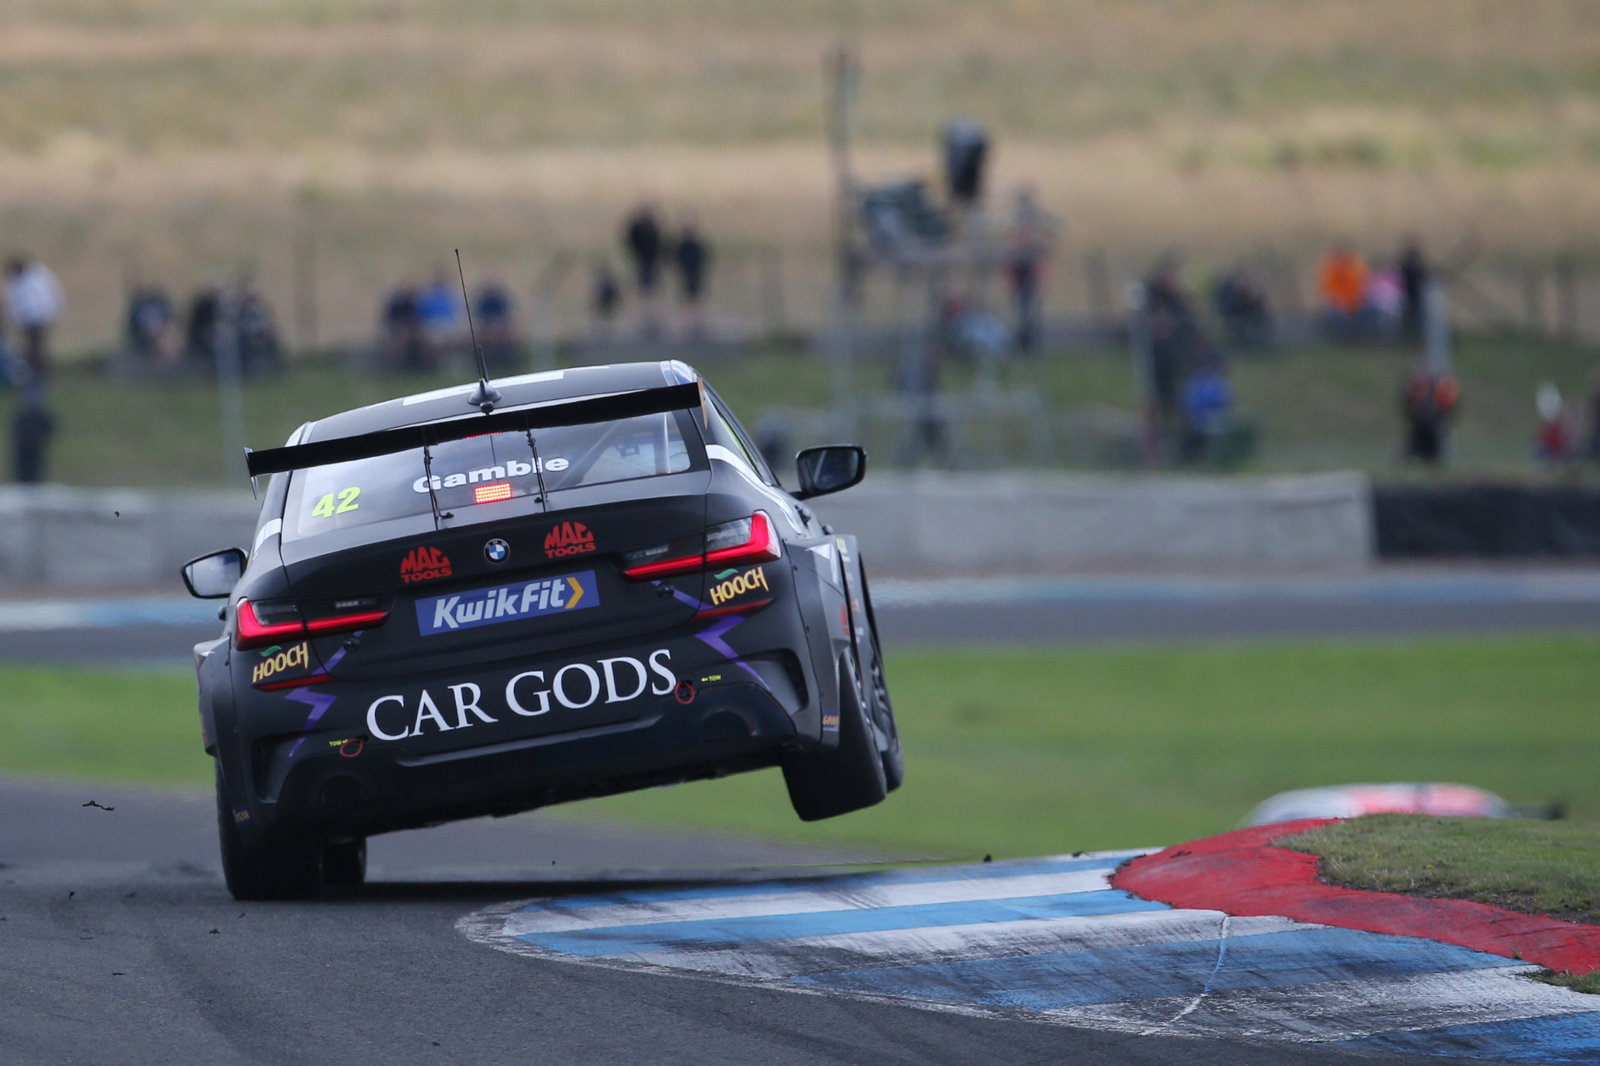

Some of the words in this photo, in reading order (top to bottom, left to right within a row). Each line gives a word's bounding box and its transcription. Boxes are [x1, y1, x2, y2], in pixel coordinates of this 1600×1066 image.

[413, 457, 569, 493] Gamble
[311, 486, 361, 518] 42
[544, 521, 595, 550] MAC
[545, 542, 596, 559] TOOLS
[401, 546, 451, 574] MAC
[401, 567, 453, 583] TOOLS
[709, 566, 769, 605] HOOCH
[252, 641, 309, 683] HOOCH
[366, 682, 499, 741] CAR
[505, 648, 677, 717] GODS
